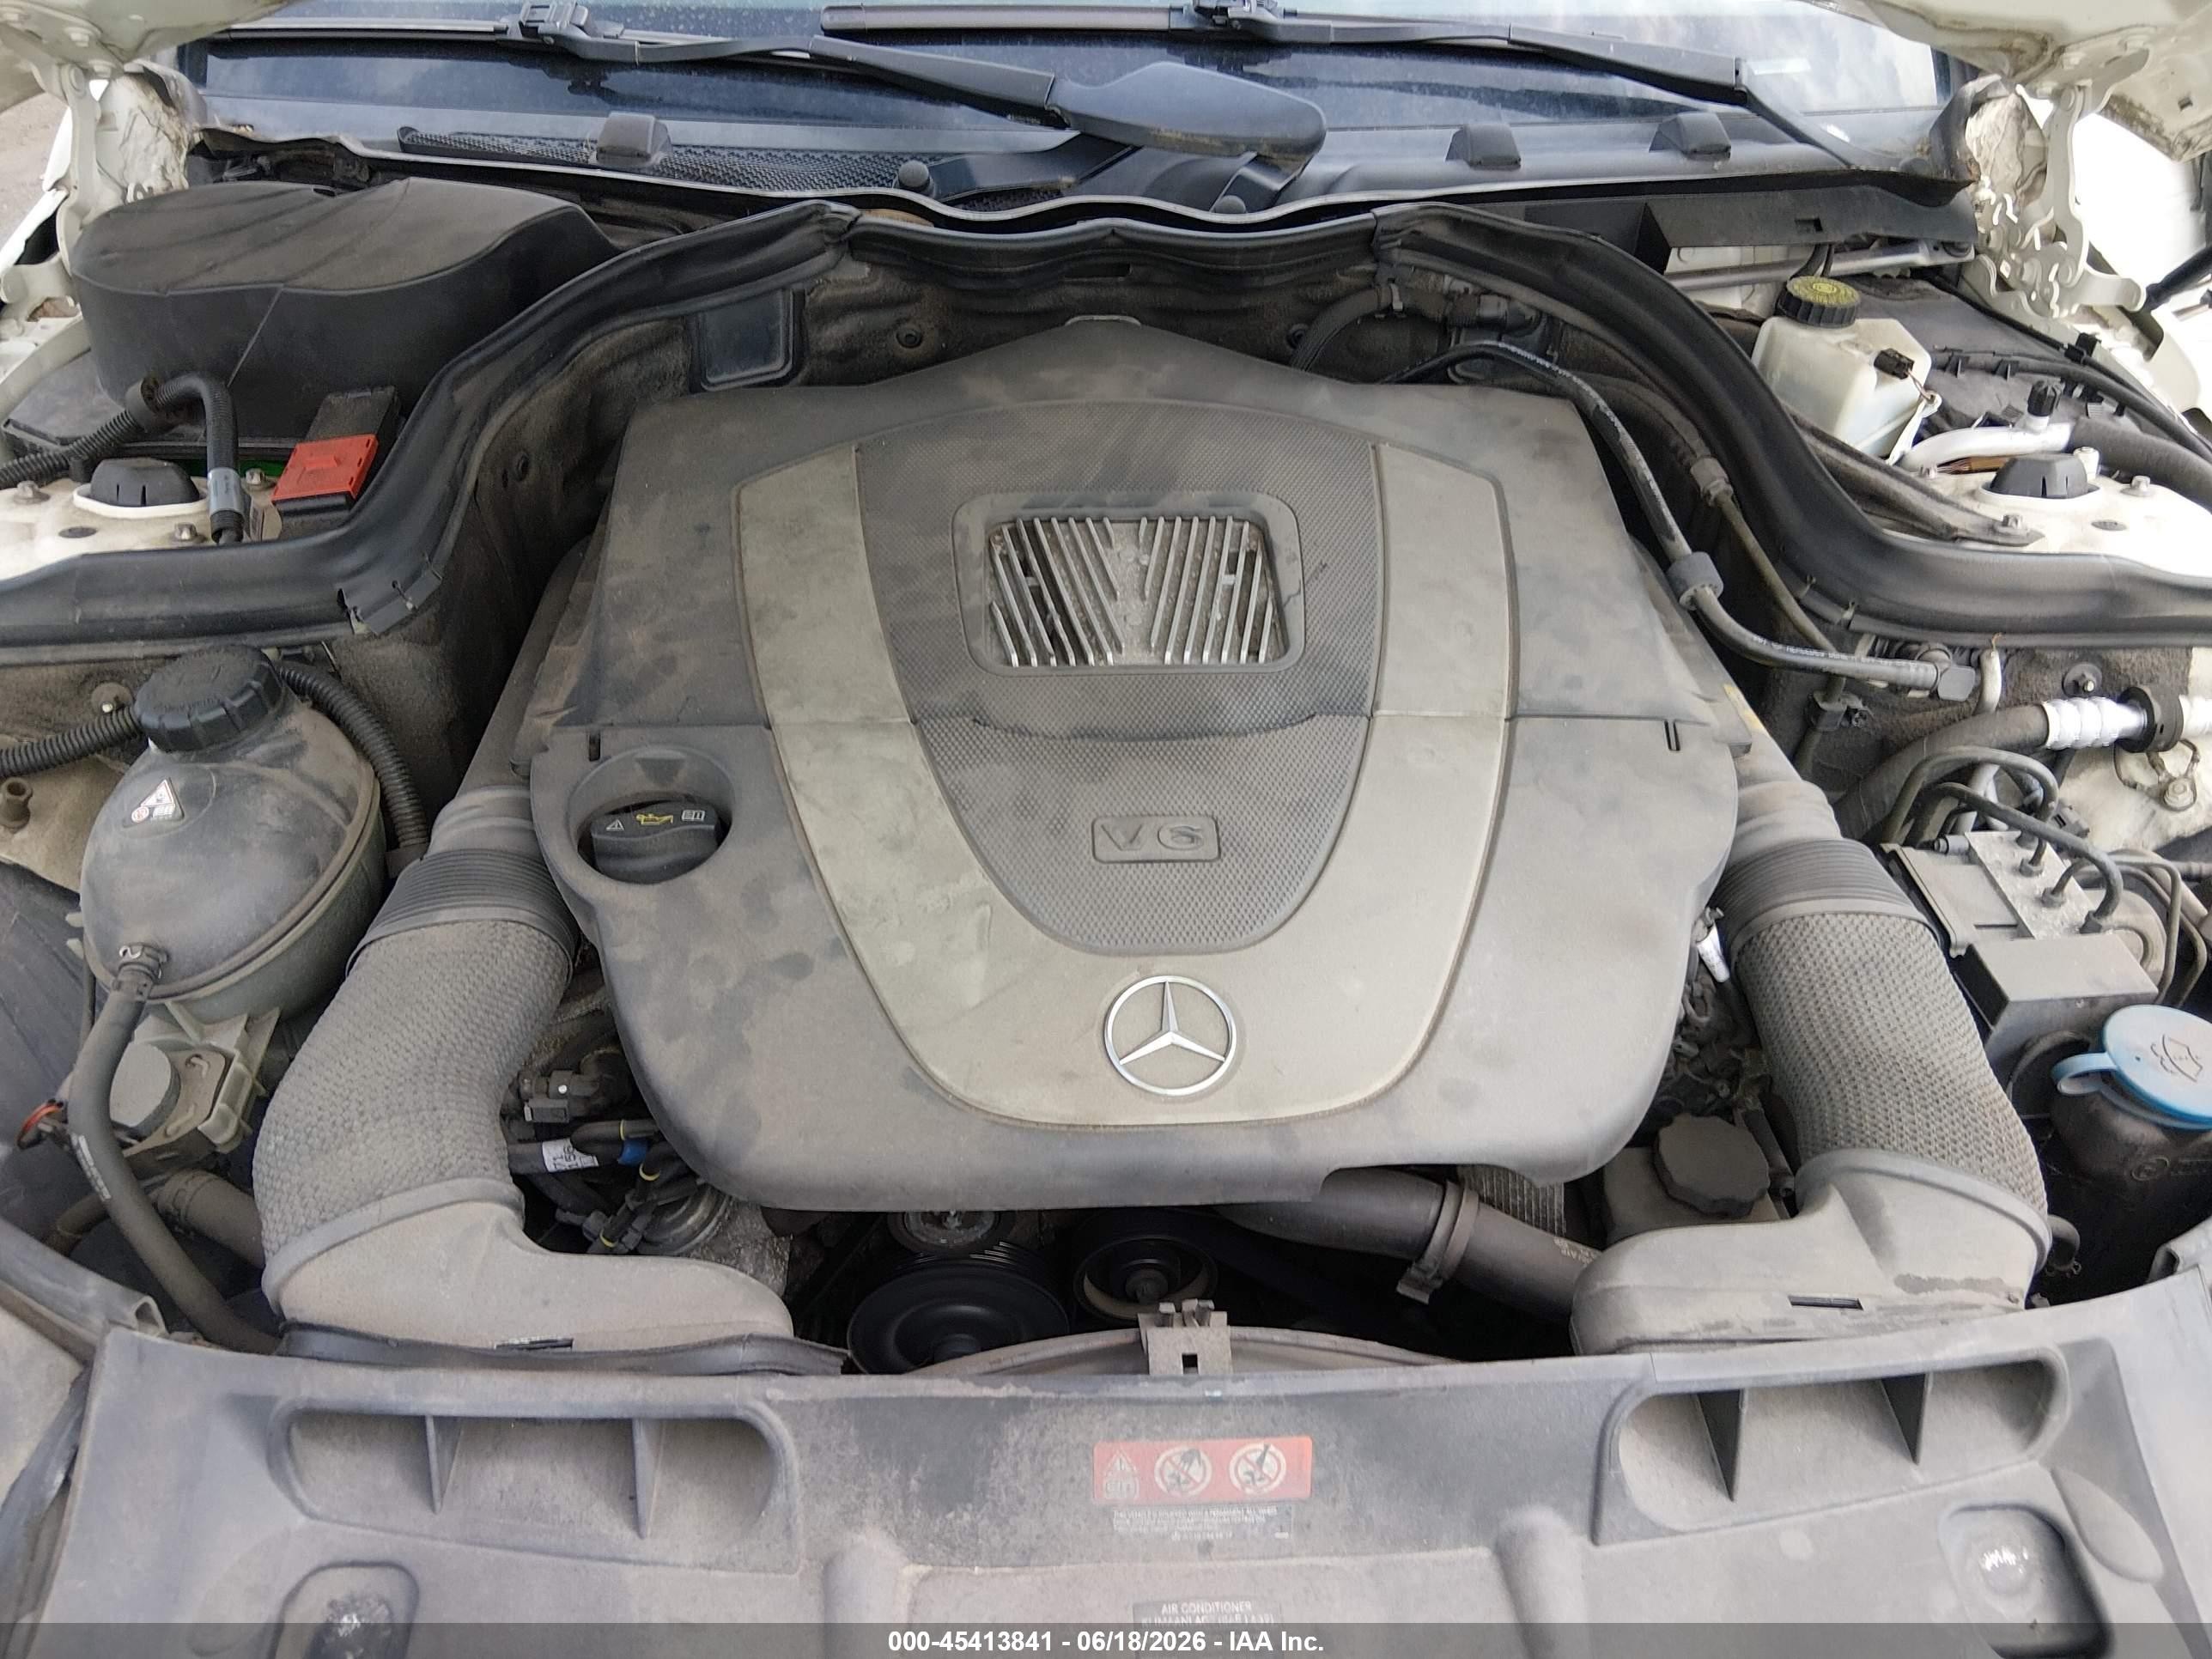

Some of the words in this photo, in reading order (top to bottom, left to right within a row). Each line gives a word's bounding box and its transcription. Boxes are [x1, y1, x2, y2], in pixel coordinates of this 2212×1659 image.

[1101, 823, 1203, 851] V6
[1161, 1602, 1178, 1614] AIR
[1181, 1600, 1252, 1613] CONDITIONER
